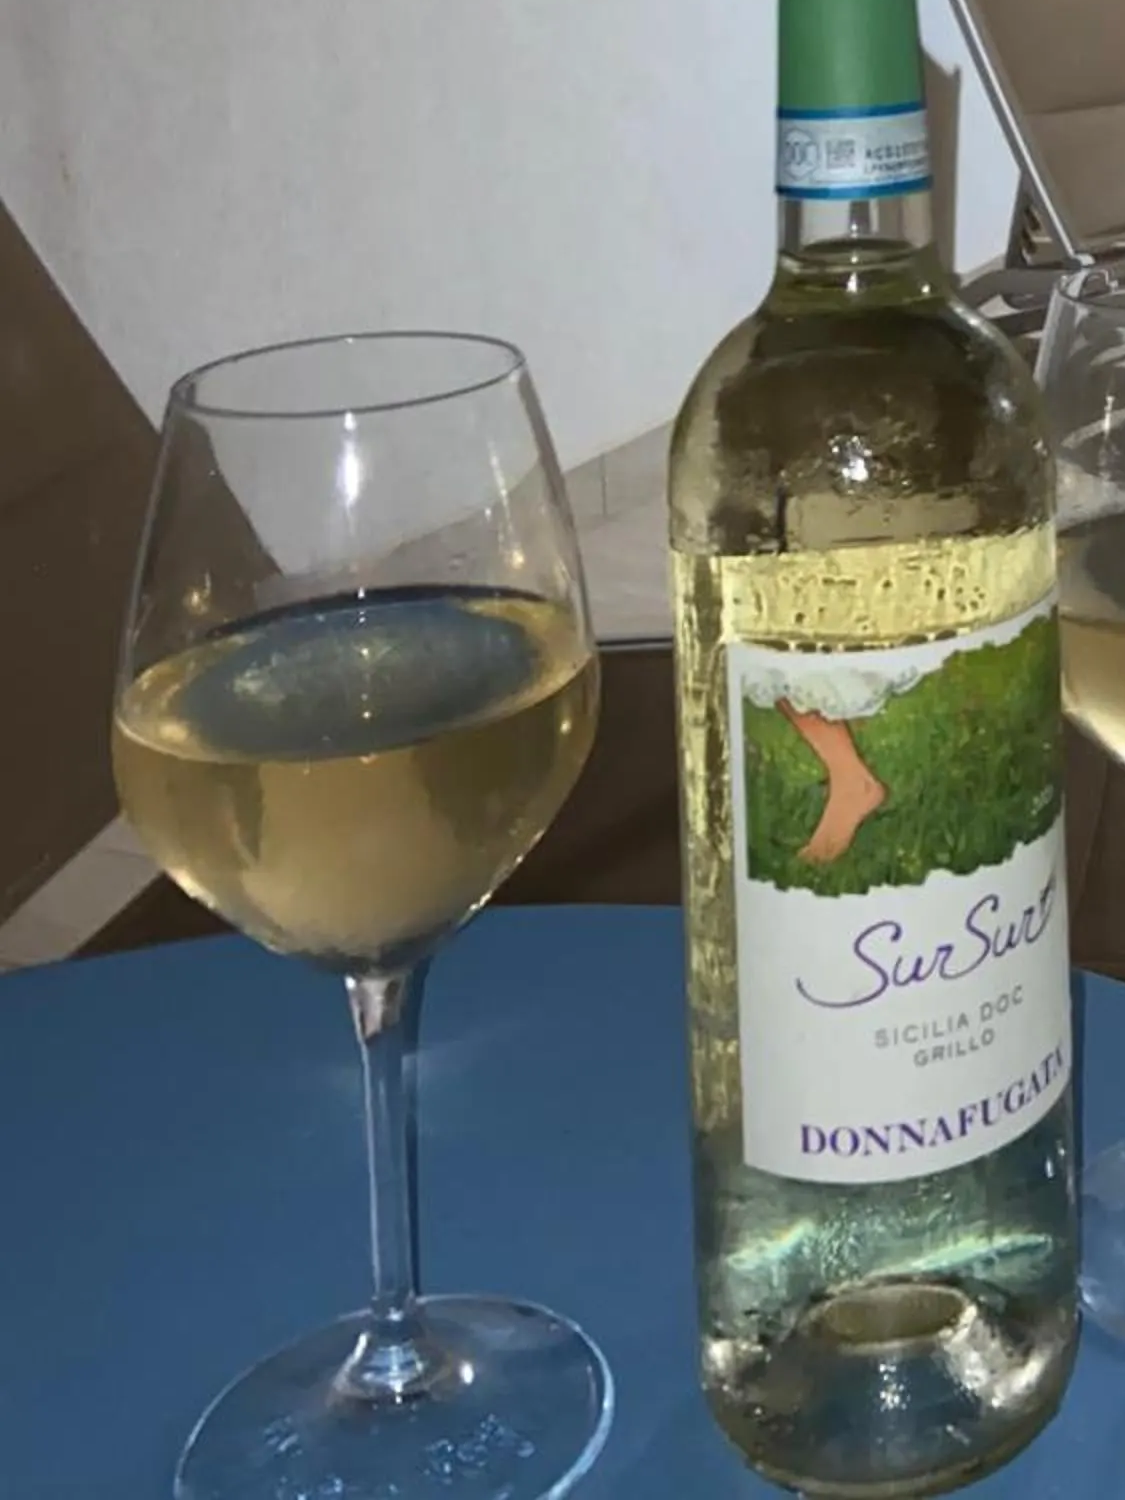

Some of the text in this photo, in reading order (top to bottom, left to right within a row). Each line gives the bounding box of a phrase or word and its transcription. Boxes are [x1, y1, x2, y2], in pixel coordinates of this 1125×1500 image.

[874, 985, 1023, 1048] SICILIA DOC
[913, 1028, 995, 1067] GRILLO
